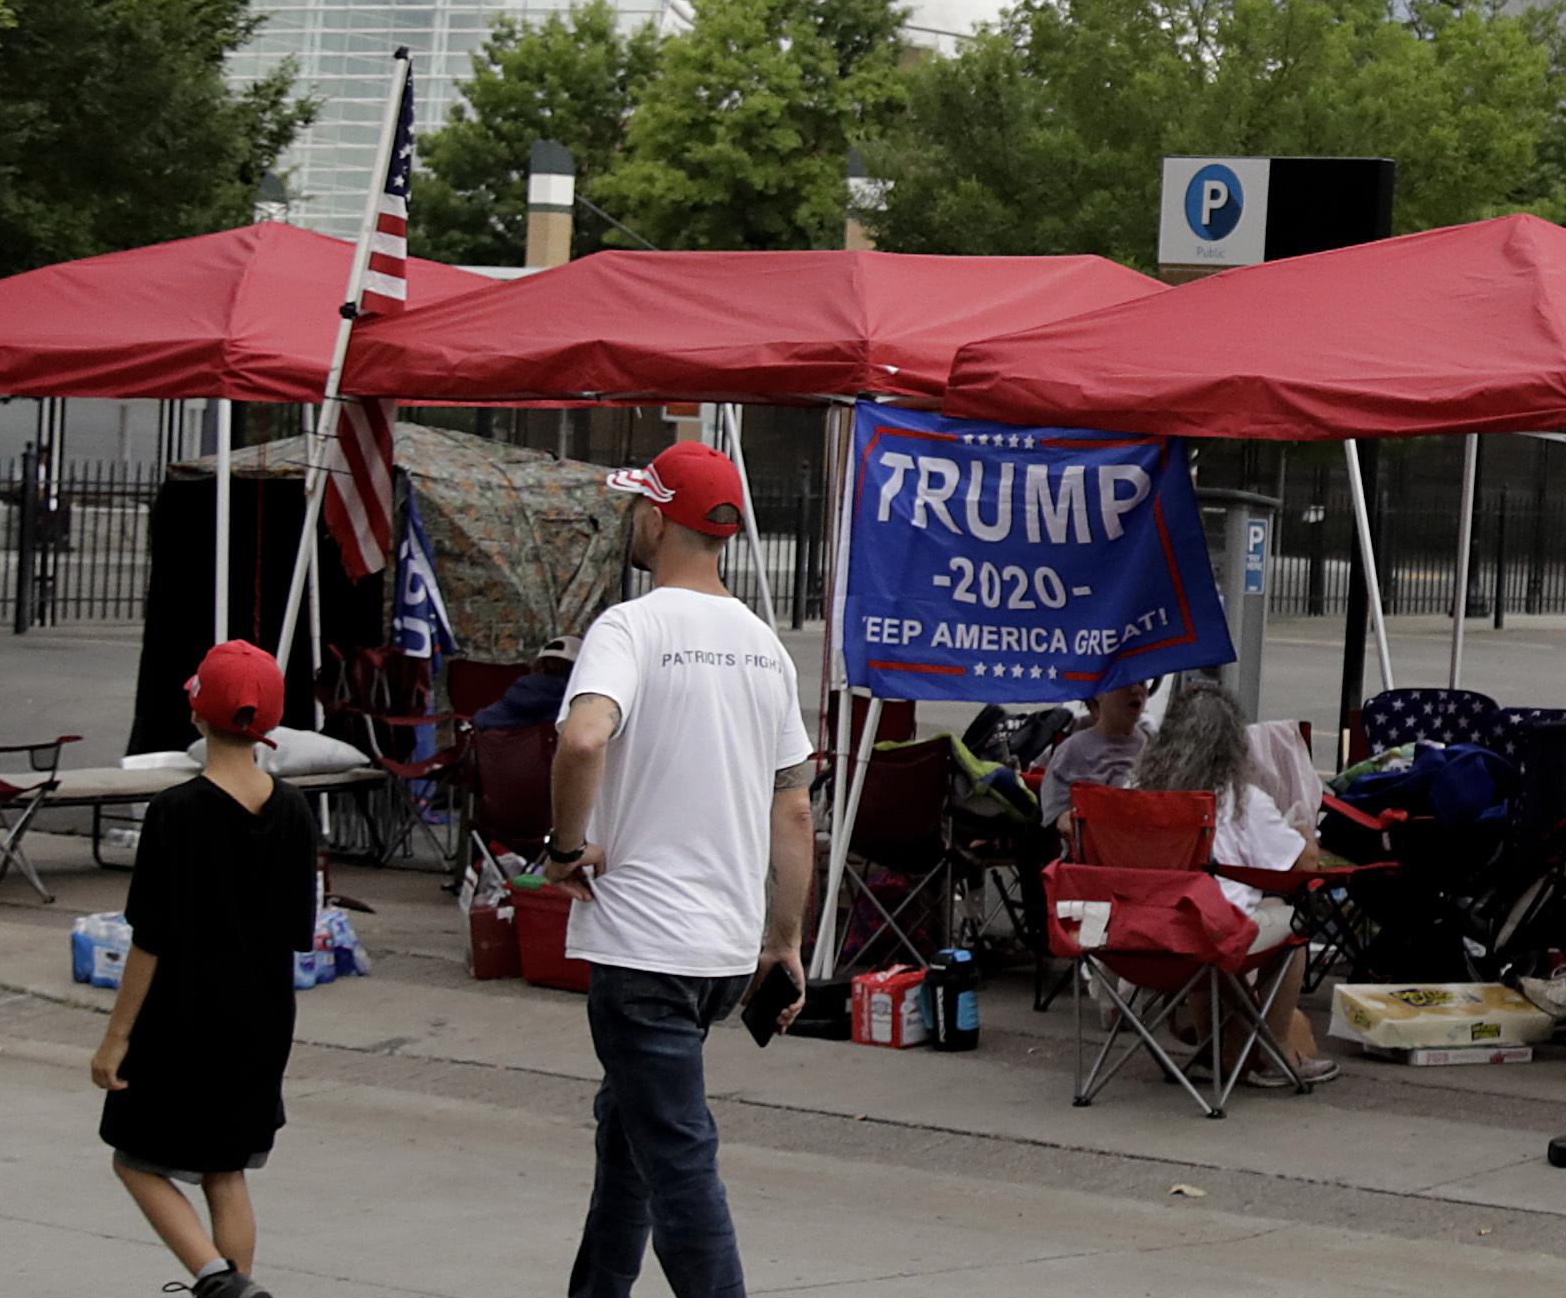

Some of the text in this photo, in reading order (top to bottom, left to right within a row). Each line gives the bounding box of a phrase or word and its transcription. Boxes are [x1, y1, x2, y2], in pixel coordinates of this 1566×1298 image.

[1201, 180, 1229, 225] P
[877, 451, 1151, 544] TRUMP
[1248, 525, 1264, 552] P
[933, 556, 1092, 610] -2020-
[862, 607, 1169, 656] EEP AMERICA GREAT!
